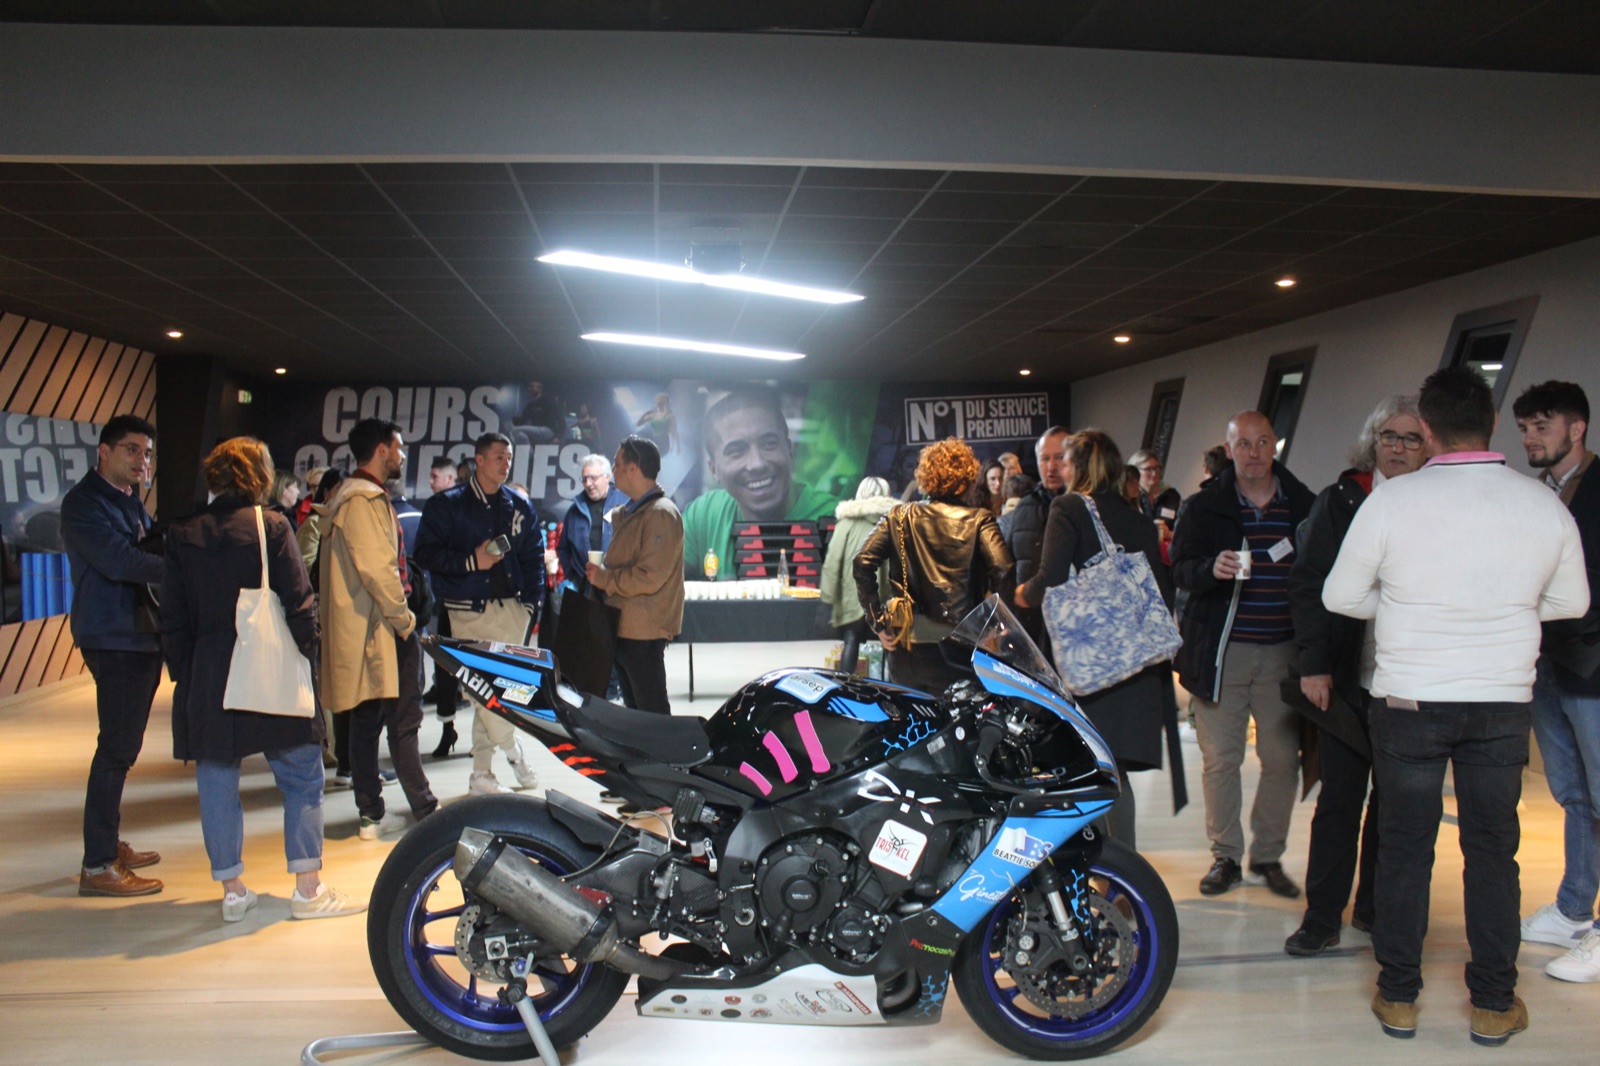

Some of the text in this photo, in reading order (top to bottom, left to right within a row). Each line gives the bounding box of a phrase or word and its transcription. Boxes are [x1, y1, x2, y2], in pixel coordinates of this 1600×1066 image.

[322, 386, 500, 443] COURS
[966, 400, 985, 418] DU
[989, 396, 1046, 417] SERVICE
[966, 417, 1032, 438] PREMIUM
